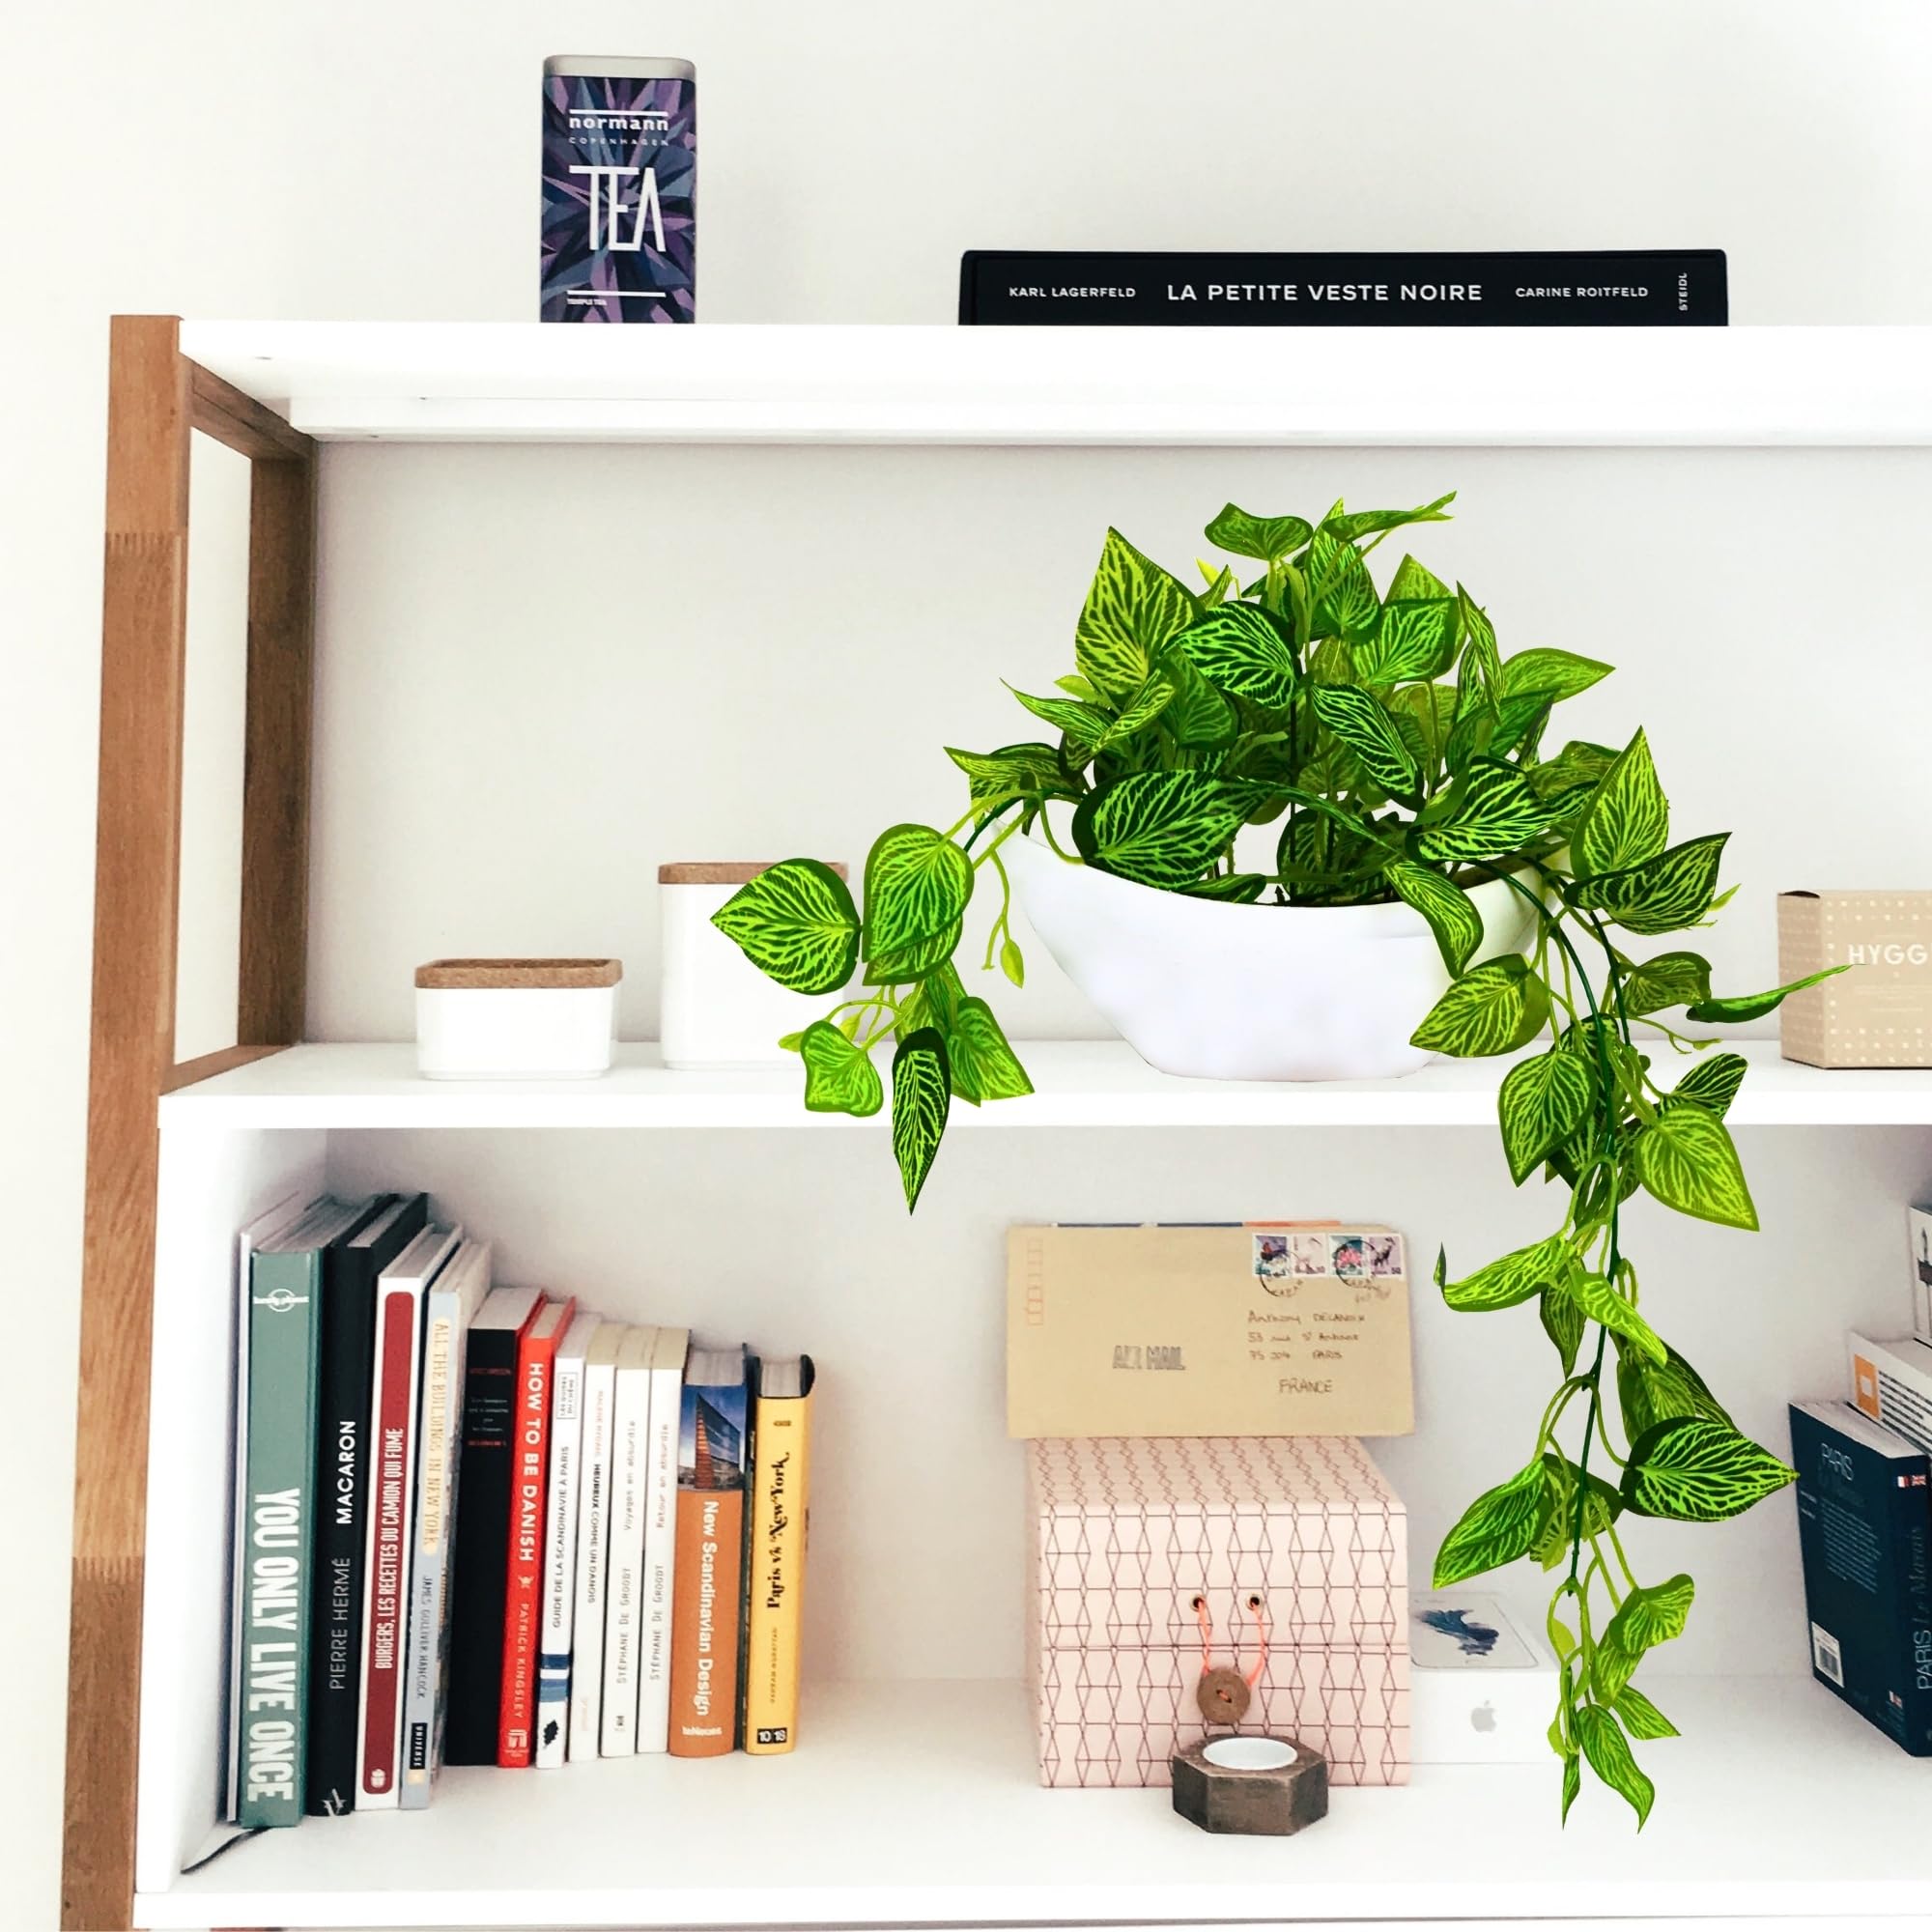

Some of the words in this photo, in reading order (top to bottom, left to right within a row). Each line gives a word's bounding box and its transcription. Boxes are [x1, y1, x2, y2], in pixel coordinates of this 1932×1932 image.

[568, 136, 669, 146] COPENHAGEN
[569, 116, 668, 131] normann
[569, 165, 667, 252] TEA
[1009, 287, 1047, 298] KARL
[1051, 287, 1136, 298] LAGERFELD
[1167, 284, 1198, 301] LA
[1208, 284, 1298, 301] PETITE
[1308, 284, 1389, 301] VESTE
[1400, 284, 1484, 301] NOIRE
[1515, 287, 1572, 298] CARINE
[1577, 287, 1649, 298] ROITFELD
[1678, 271, 1689, 312] STEIDL
[1847, 943, 1932, 966] HYGG
[434, 1322, 449, 1345] ALL
[432, 1352, 447, 1379] THE
[1278, 1377, 1333, 1393] FRANCE
[526, 1362, 544, 1411] HOW
[430, 1383, 445, 1452] BUILDINGS
[525, 1418, 542, 1445] TO
[384, 1428, 404, 1459] FUME
[559, 1446, 569, 1475] PARIS
[336, 1420, 356, 1524] MACARON
[383, 1462, 404, 1478] QUI
[428, 1458, 442, 1473] IN
[523, 1453, 540, 1476] BE
[769, 1451, 790, 1503] York
[381, 1481, 401, 1525] CAMION
[426, 1476, 441, 1506] NEW
[591, 1463, 601, 1509] HEUREUX
[252, 1488, 300, 1548] YOU
[423, 1509, 440, 1546] YORK
[519, 1485, 538, 1562] DANISH
[555, 1488, 567, 1559] SCANDINAVIE
[589, 1511, 600, 1547] COMME
[702, 1500, 720, 1537] New
[768, 1502, 788, 1543] New
[378, 1544, 398, 1595] RECETTES
[554, 1562, 564, 1576] LA
[589, 1550, 598, 1564] UN
[251, 1555, 299, 1632] ONLY
[331, 1557, 352, 1621] HERMÉ
[421, 1575, 433, 1605] JAMES
[554, 1579, 564, 1593] DE
[587, 1567, 597, 1604] DANOIS
[697, 1541, 718, 1653] Scandinavian
[766, 1568, 785, 1608] Paris
[377, 1598, 396, 1617] LES
[553, 1596, 562, 1628] GUIDE
[375, 1619, 396, 1669] BURGERS,
[419, 1609, 431, 1652] GULLIVER
[517, 1603, 530, 1654] PATRICK
[248, 1642, 297, 1712] LIVE
[328, 1629, 349, 1690] PIERRE
[416, 1655, 428, 1699] HANCOCK
[1913, 1630, 1932, 1690] PARIS
[514, 1658, 526, 1719] KINGSLEY
[693, 1659, 714, 1717] Design
[246, 1720, 296, 1804] ONCE
[412, 1725, 424, 1768] UNIVERSE
